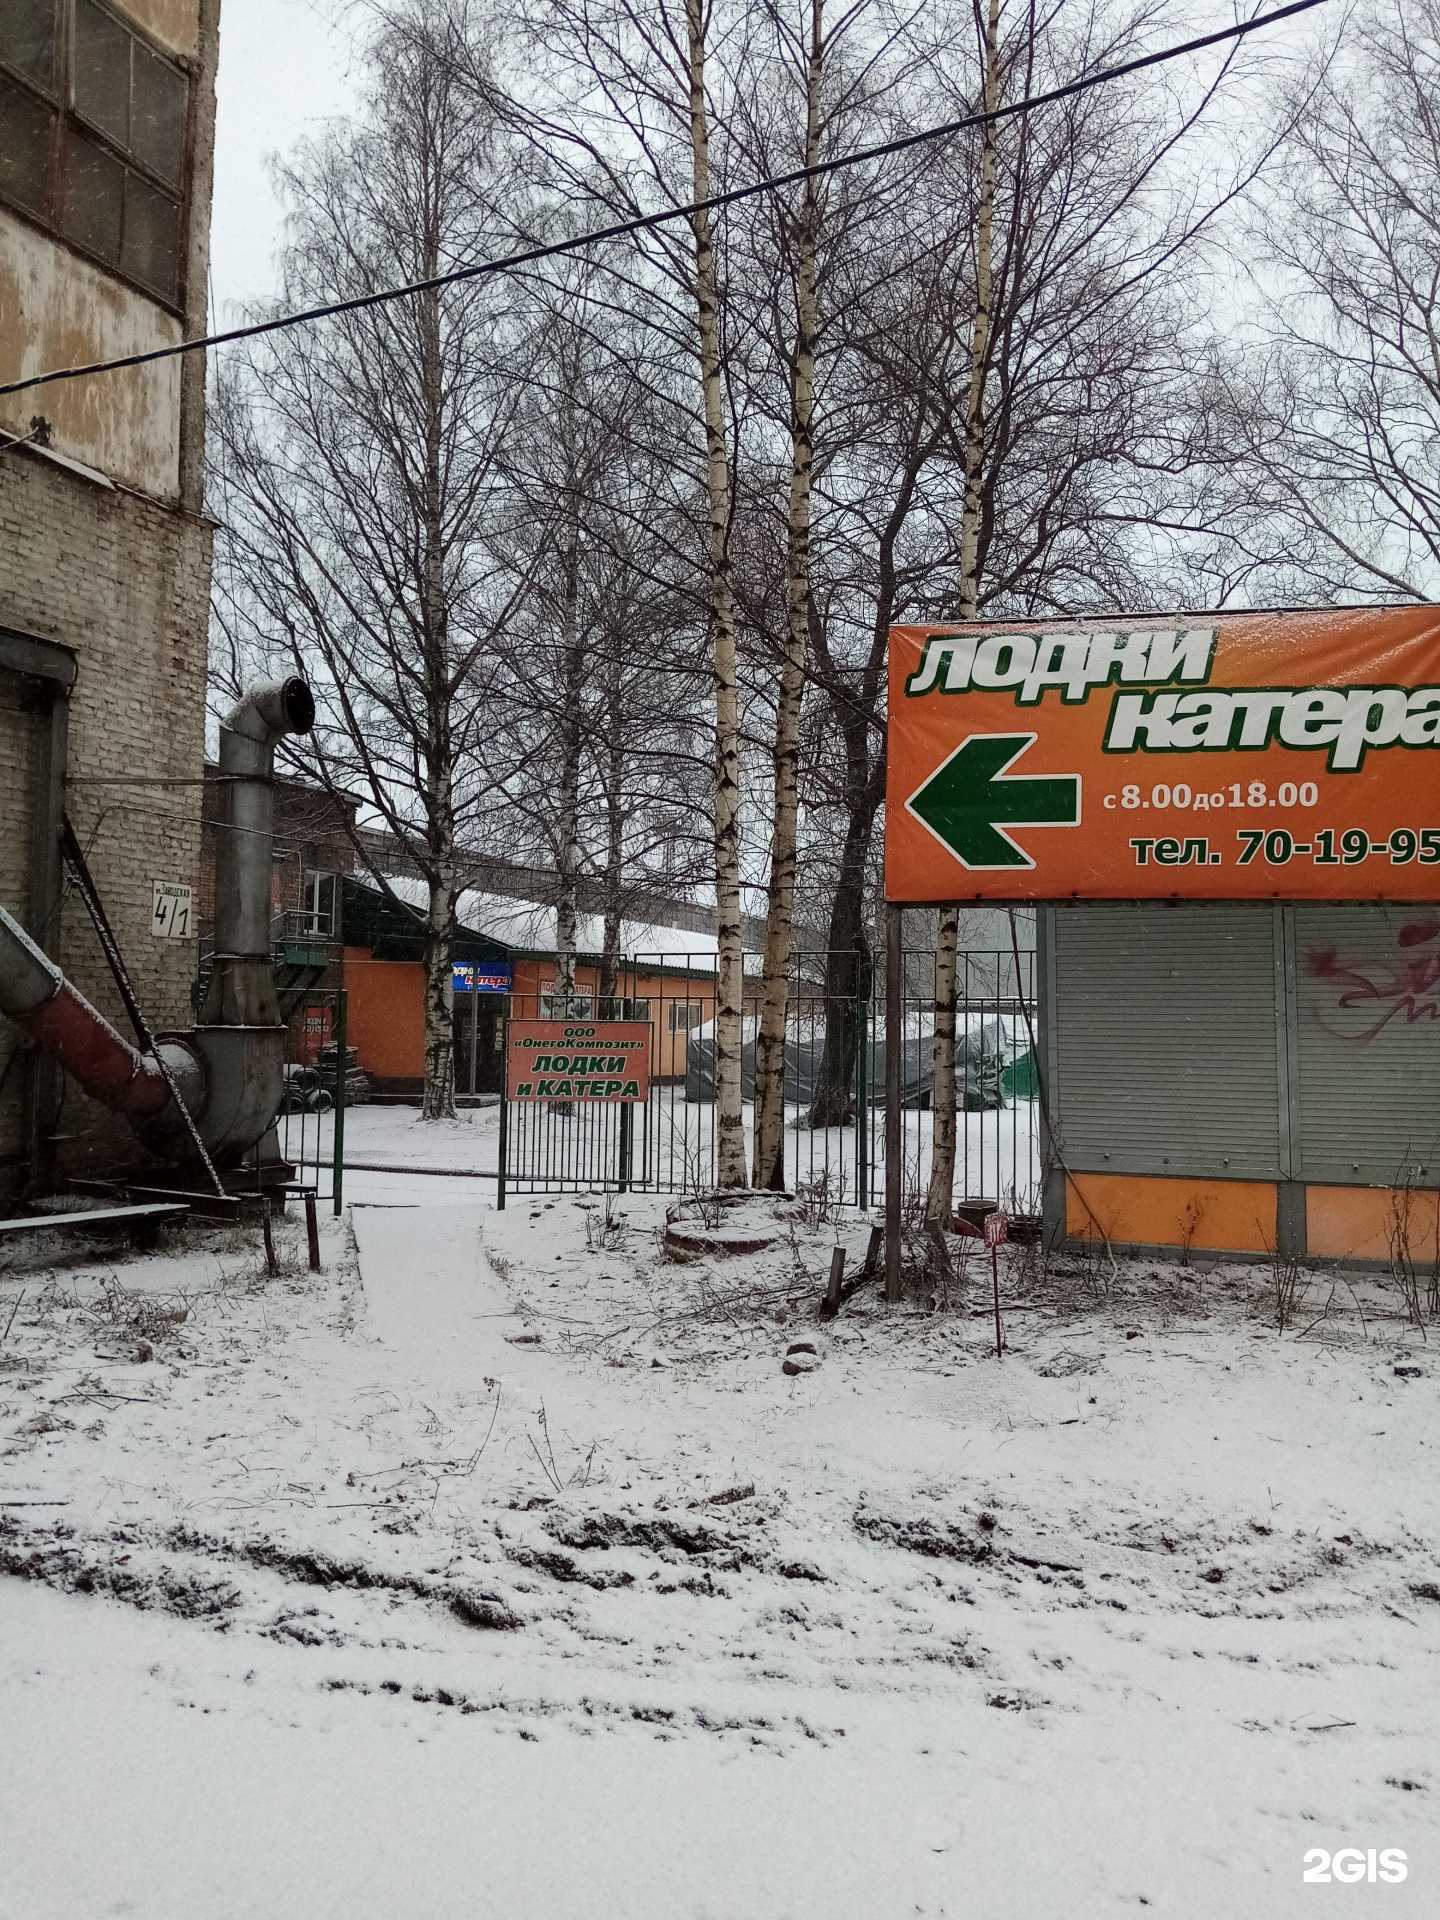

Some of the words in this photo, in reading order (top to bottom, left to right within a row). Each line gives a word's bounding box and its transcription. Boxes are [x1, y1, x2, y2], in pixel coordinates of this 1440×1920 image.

[905, 630, 1217, 707] лодки
[1103, 686, 1440, 774] катера
[1128, 836, 1222, 866] тел.
[1234, 827, 1440, 866] 70-19-95
[154, 894, 189, 938] 4/1
[513, 1037, 645, 1050] «ОнегоКомпозит»
[563, 1027, 596, 1038] ООО
[530, 1054, 628, 1077] ЛОДКИ
[515, 1082, 534, 1097] и
[536, 1079, 641, 1098] КАТЕРА
